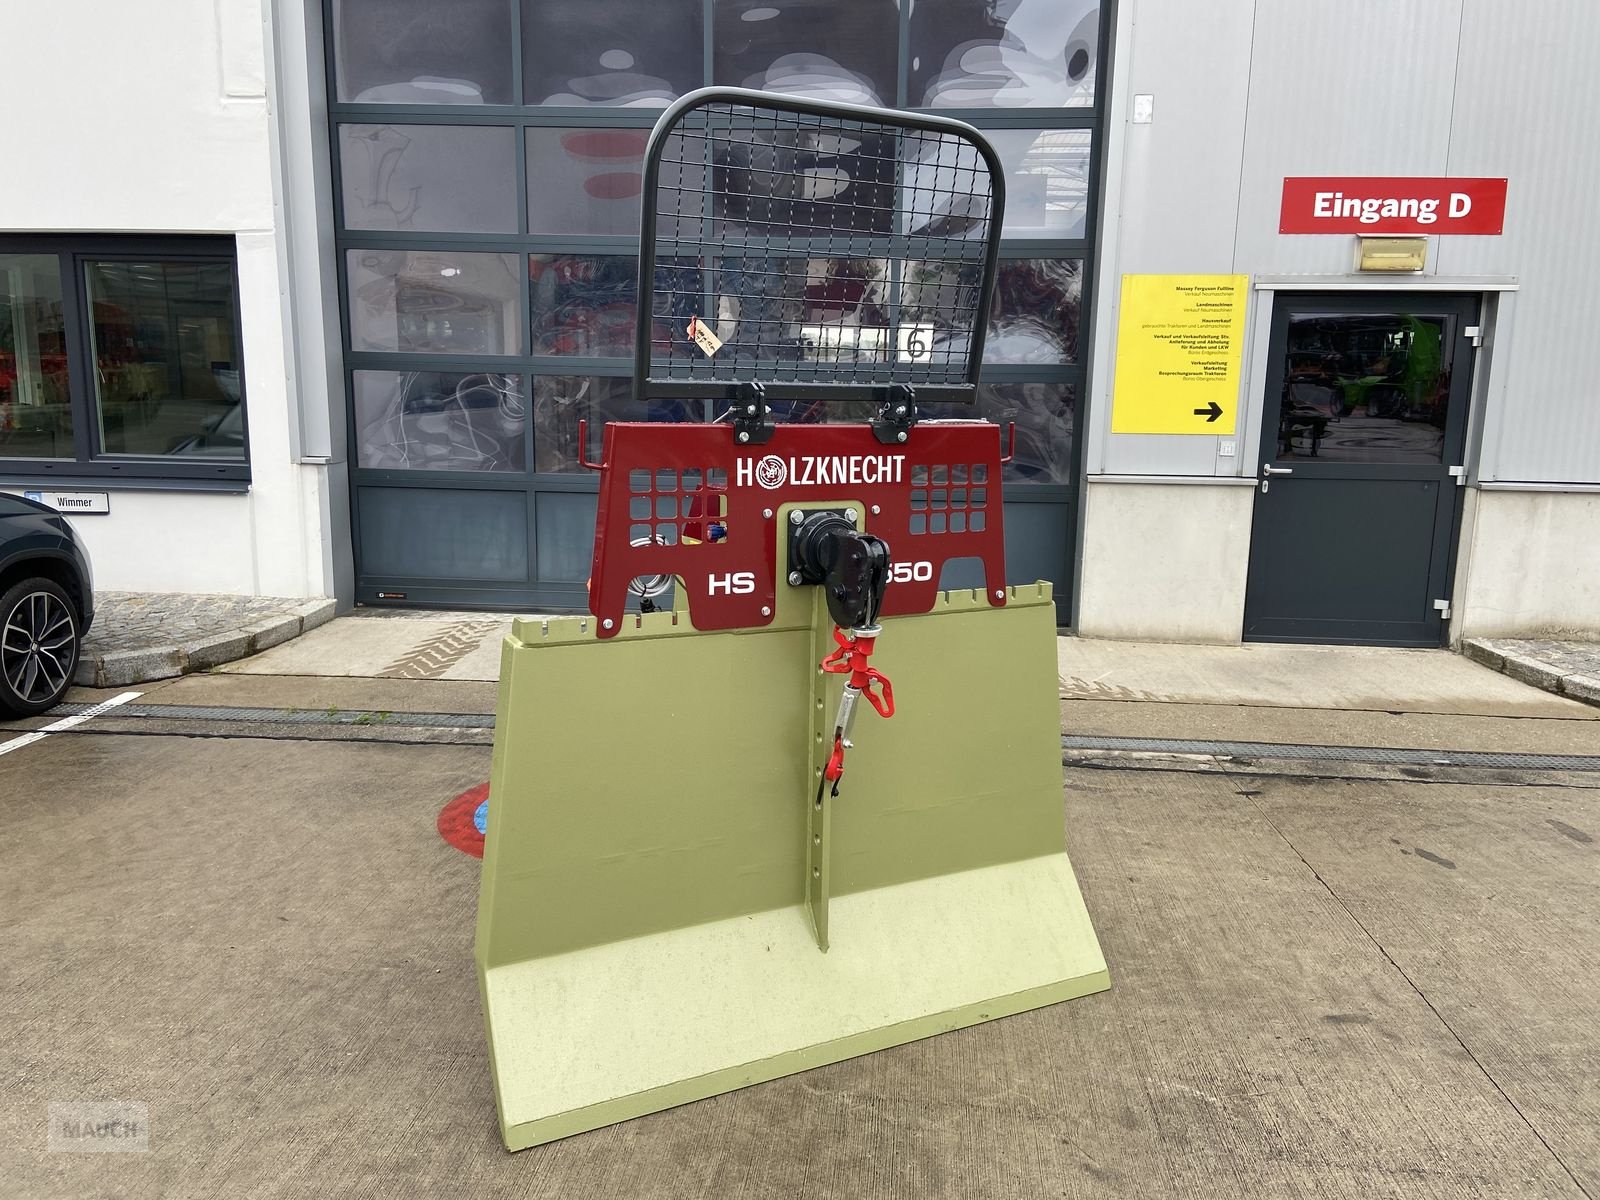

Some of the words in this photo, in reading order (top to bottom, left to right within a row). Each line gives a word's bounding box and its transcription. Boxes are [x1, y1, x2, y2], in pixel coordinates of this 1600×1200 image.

[1313, 192, 1440, 224] Eingang
[1448, 192, 1472, 218] D
[907, 329, 925, 358] 6
[57, 497, 92, 507] Wimmer
[708, 572, 756, 596] HS
